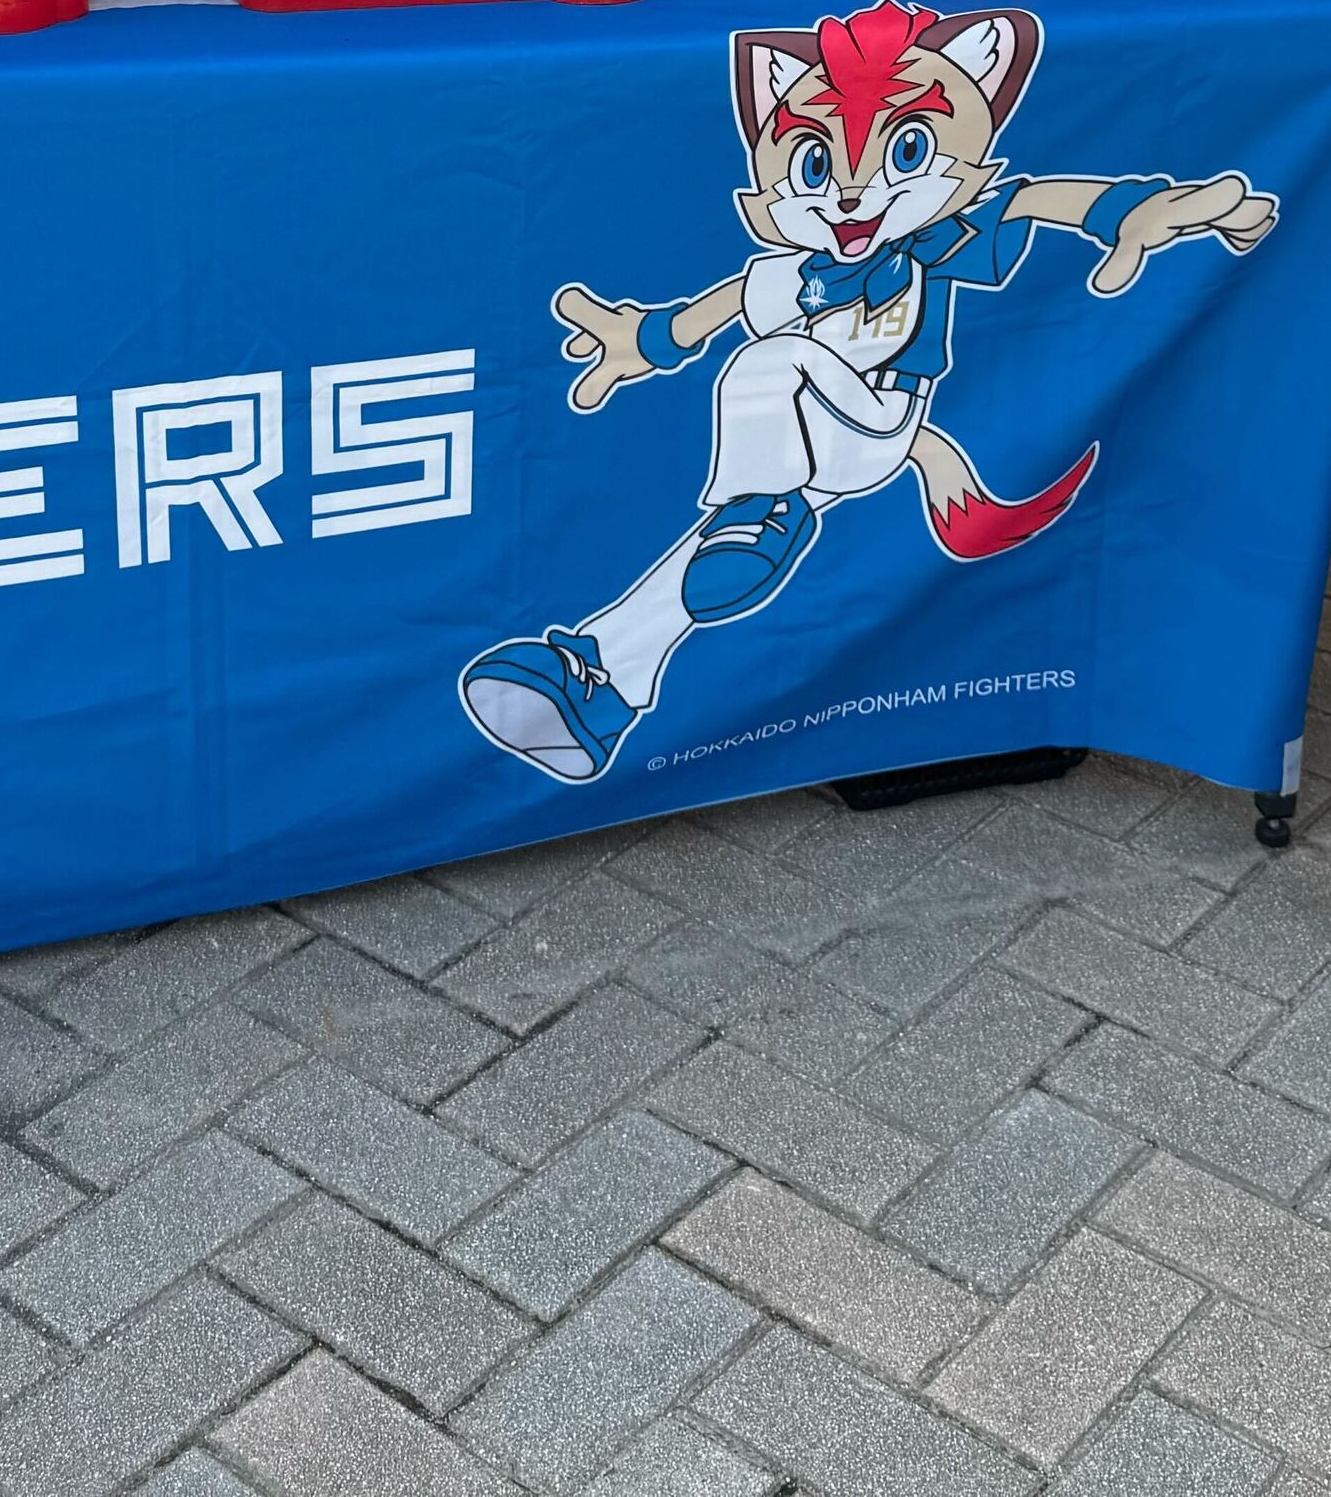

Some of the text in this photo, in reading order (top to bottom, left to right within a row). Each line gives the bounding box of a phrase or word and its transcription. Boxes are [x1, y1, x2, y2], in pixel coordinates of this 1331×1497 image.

[672, 718, 796, 769] HOKKAIDO
[803, 684, 947, 730] NIPPONHAM
[954, 669, 1076, 701] FIGHTERS
